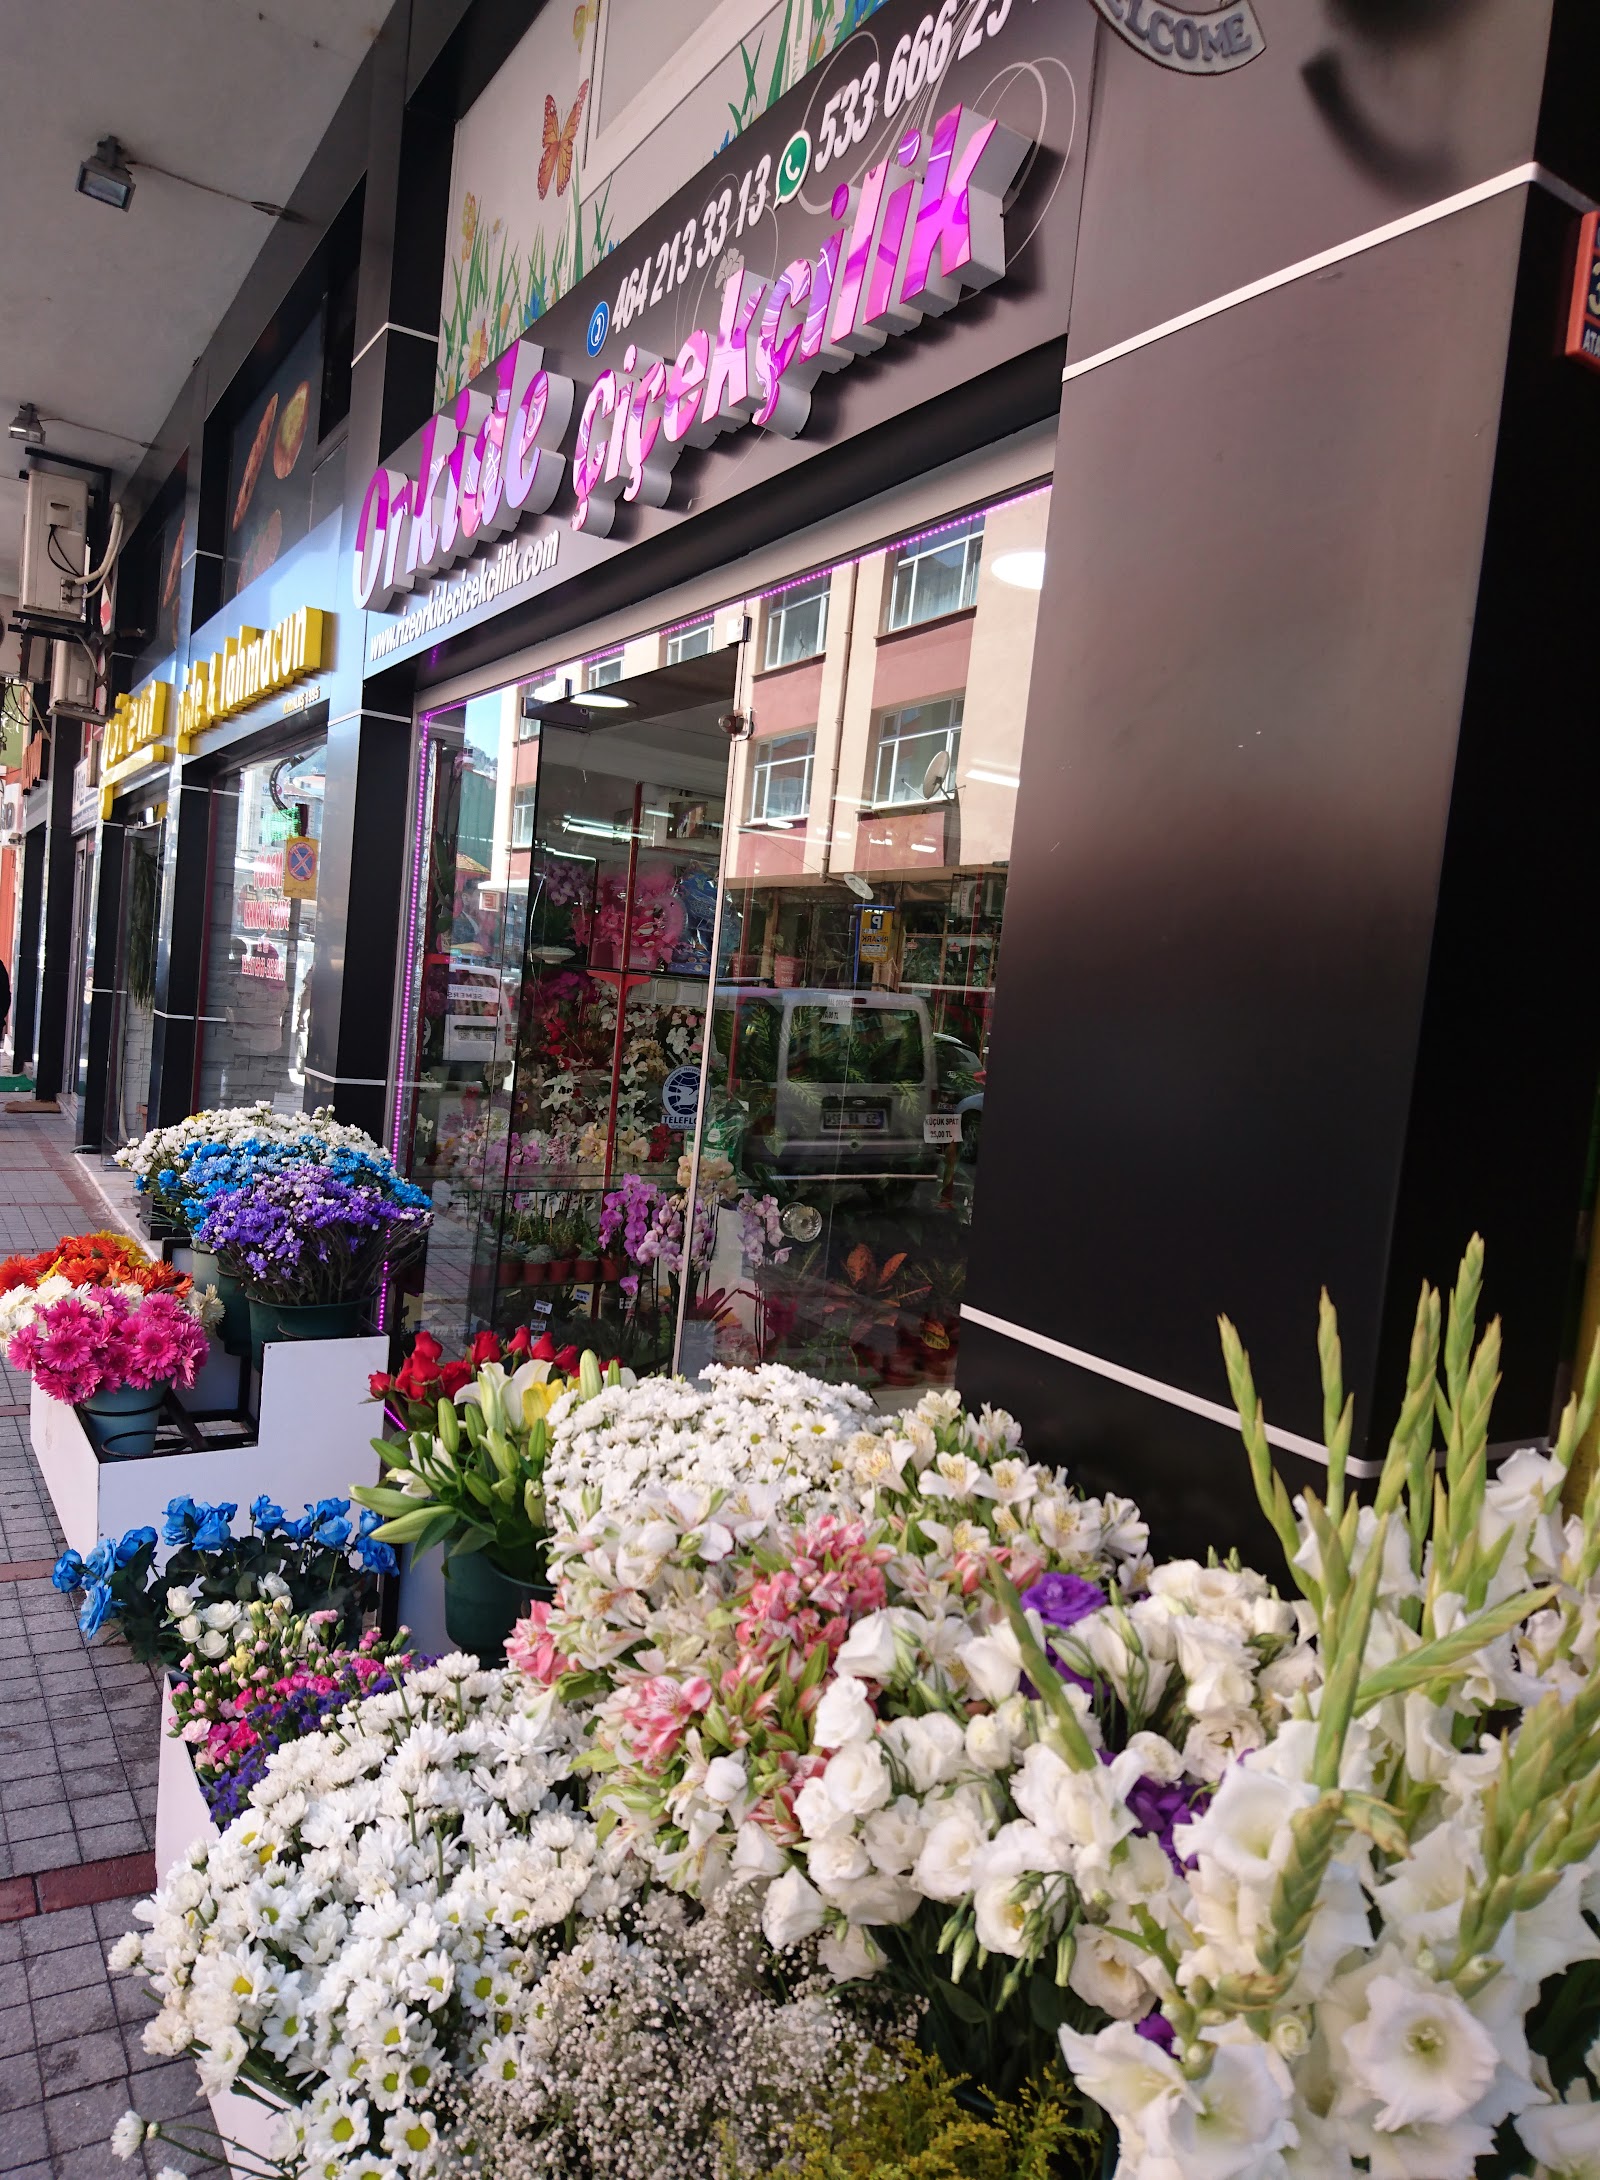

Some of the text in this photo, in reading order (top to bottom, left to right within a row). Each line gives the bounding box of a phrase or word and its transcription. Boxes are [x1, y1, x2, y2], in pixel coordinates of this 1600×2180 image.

[611, 256, 652, 334] 464
[650, 218, 697, 307] 213
[696, 188, 732, 268] 33
[736, 154, 772, 238] 13
[815, 61, 881, 173] 533
[884, 0, 957, 118] 666
[352, 102, 998, 610] Orkide Çiçekçilik
[370, 529, 560, 662] www.rizeorkidecicekcilik.com
[664, 1116, 699, 1125] TELEFL
